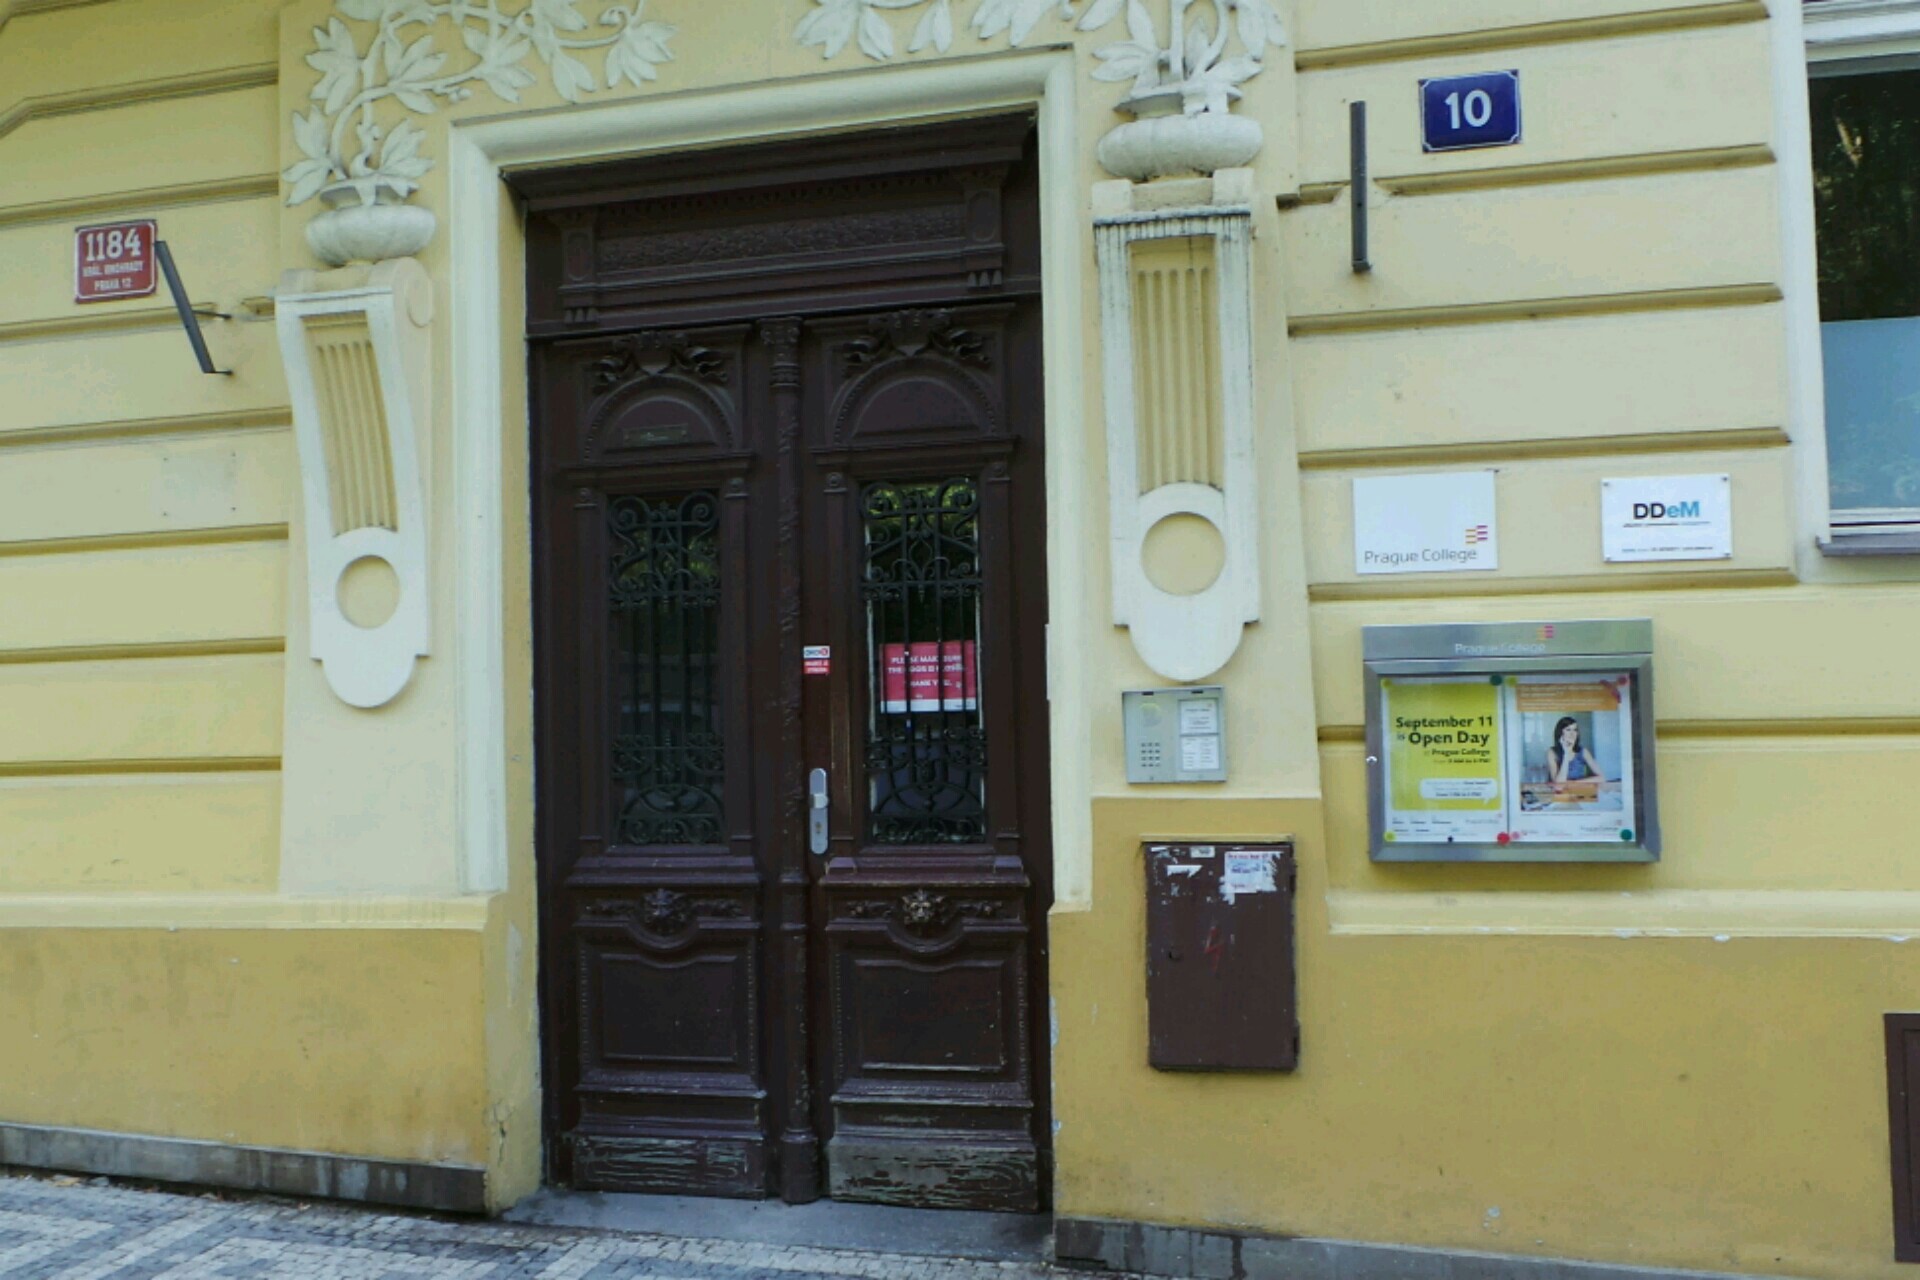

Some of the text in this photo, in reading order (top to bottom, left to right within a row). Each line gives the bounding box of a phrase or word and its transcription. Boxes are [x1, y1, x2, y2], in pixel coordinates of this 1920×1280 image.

[1444, 89, 1492, 129] 10
[86, 228, 141, 261] 1184
[1633, 500, 1700, 519] DDeM
[1364, 548, 1478, 567] Prague College
[1396, 715, 1493, 731] September 11
[1408, 731, 1453, 747] Open
[1457, 730, 1490, 747] Day
